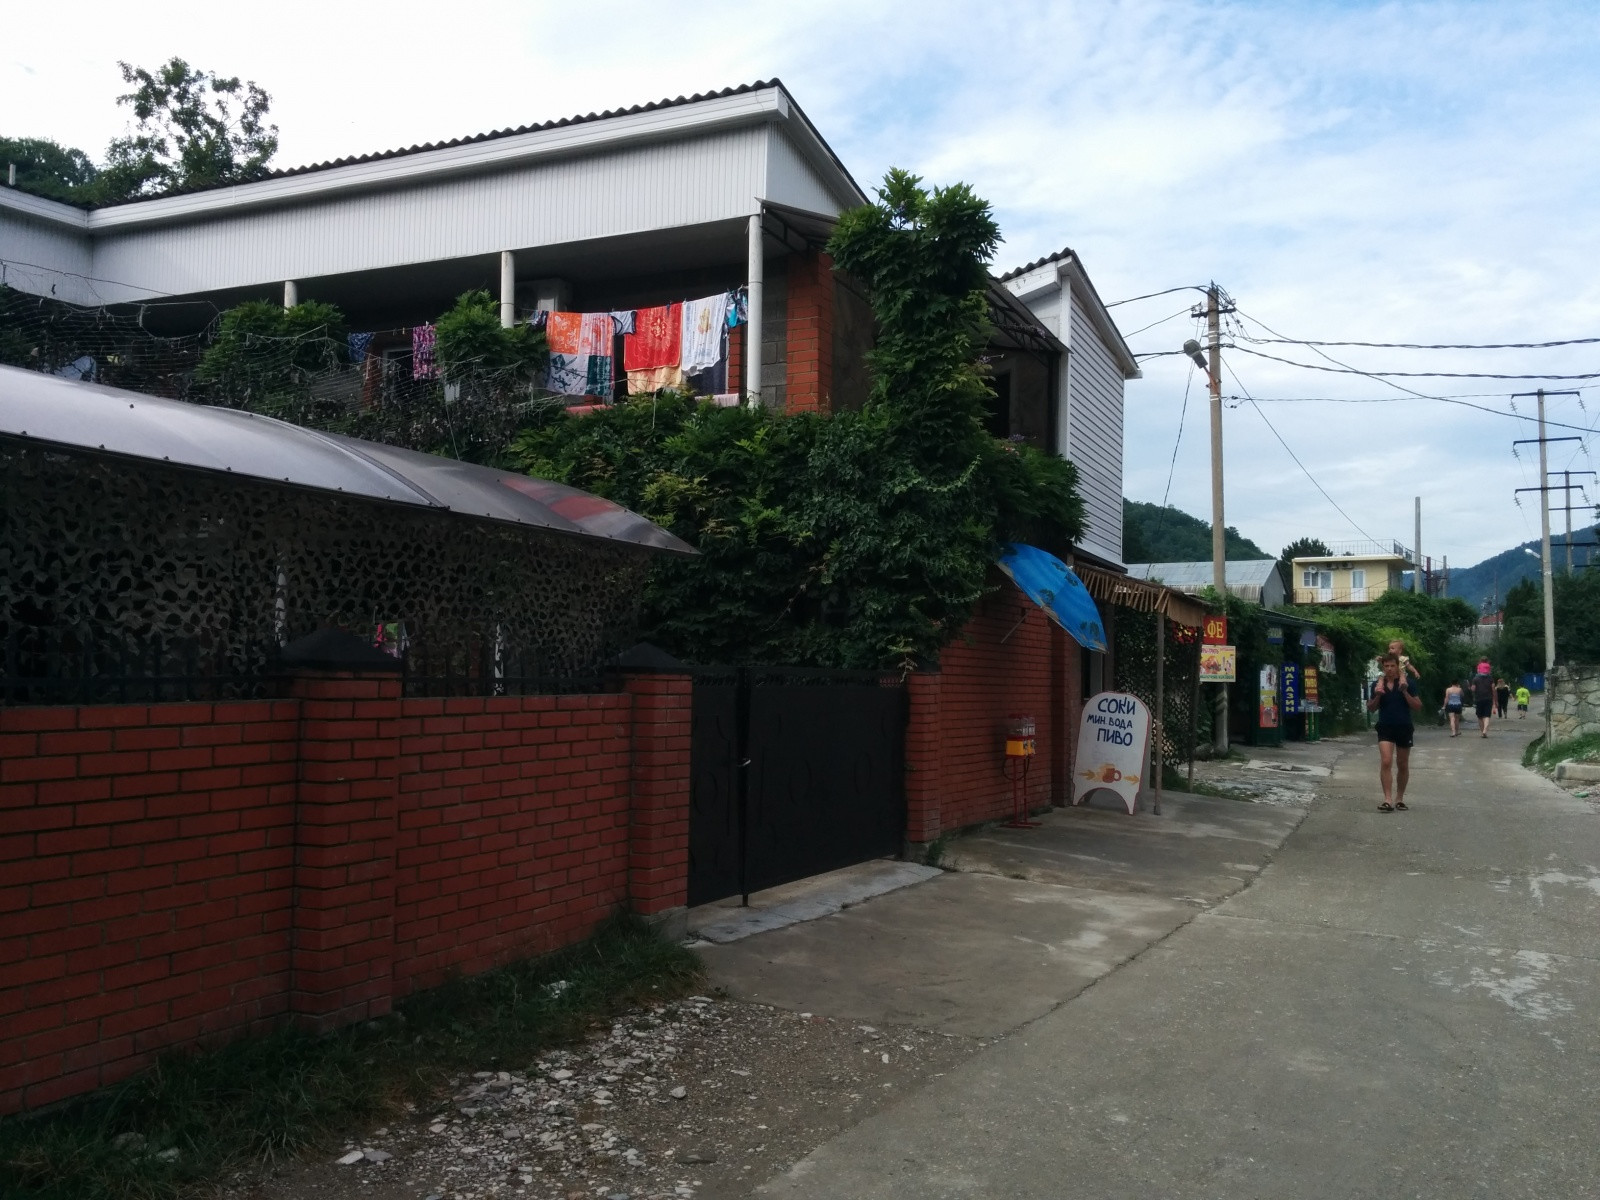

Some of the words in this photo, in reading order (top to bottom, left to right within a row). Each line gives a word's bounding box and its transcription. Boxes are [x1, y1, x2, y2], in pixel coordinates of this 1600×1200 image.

[1284, 666, 1295, 712] МАГАЗИН
[1097, 697, 1136, 715] СОКИ
[1108, 717, 1133, 730] ВОДА
[1097, 728, 1133, 746] ПИВО
